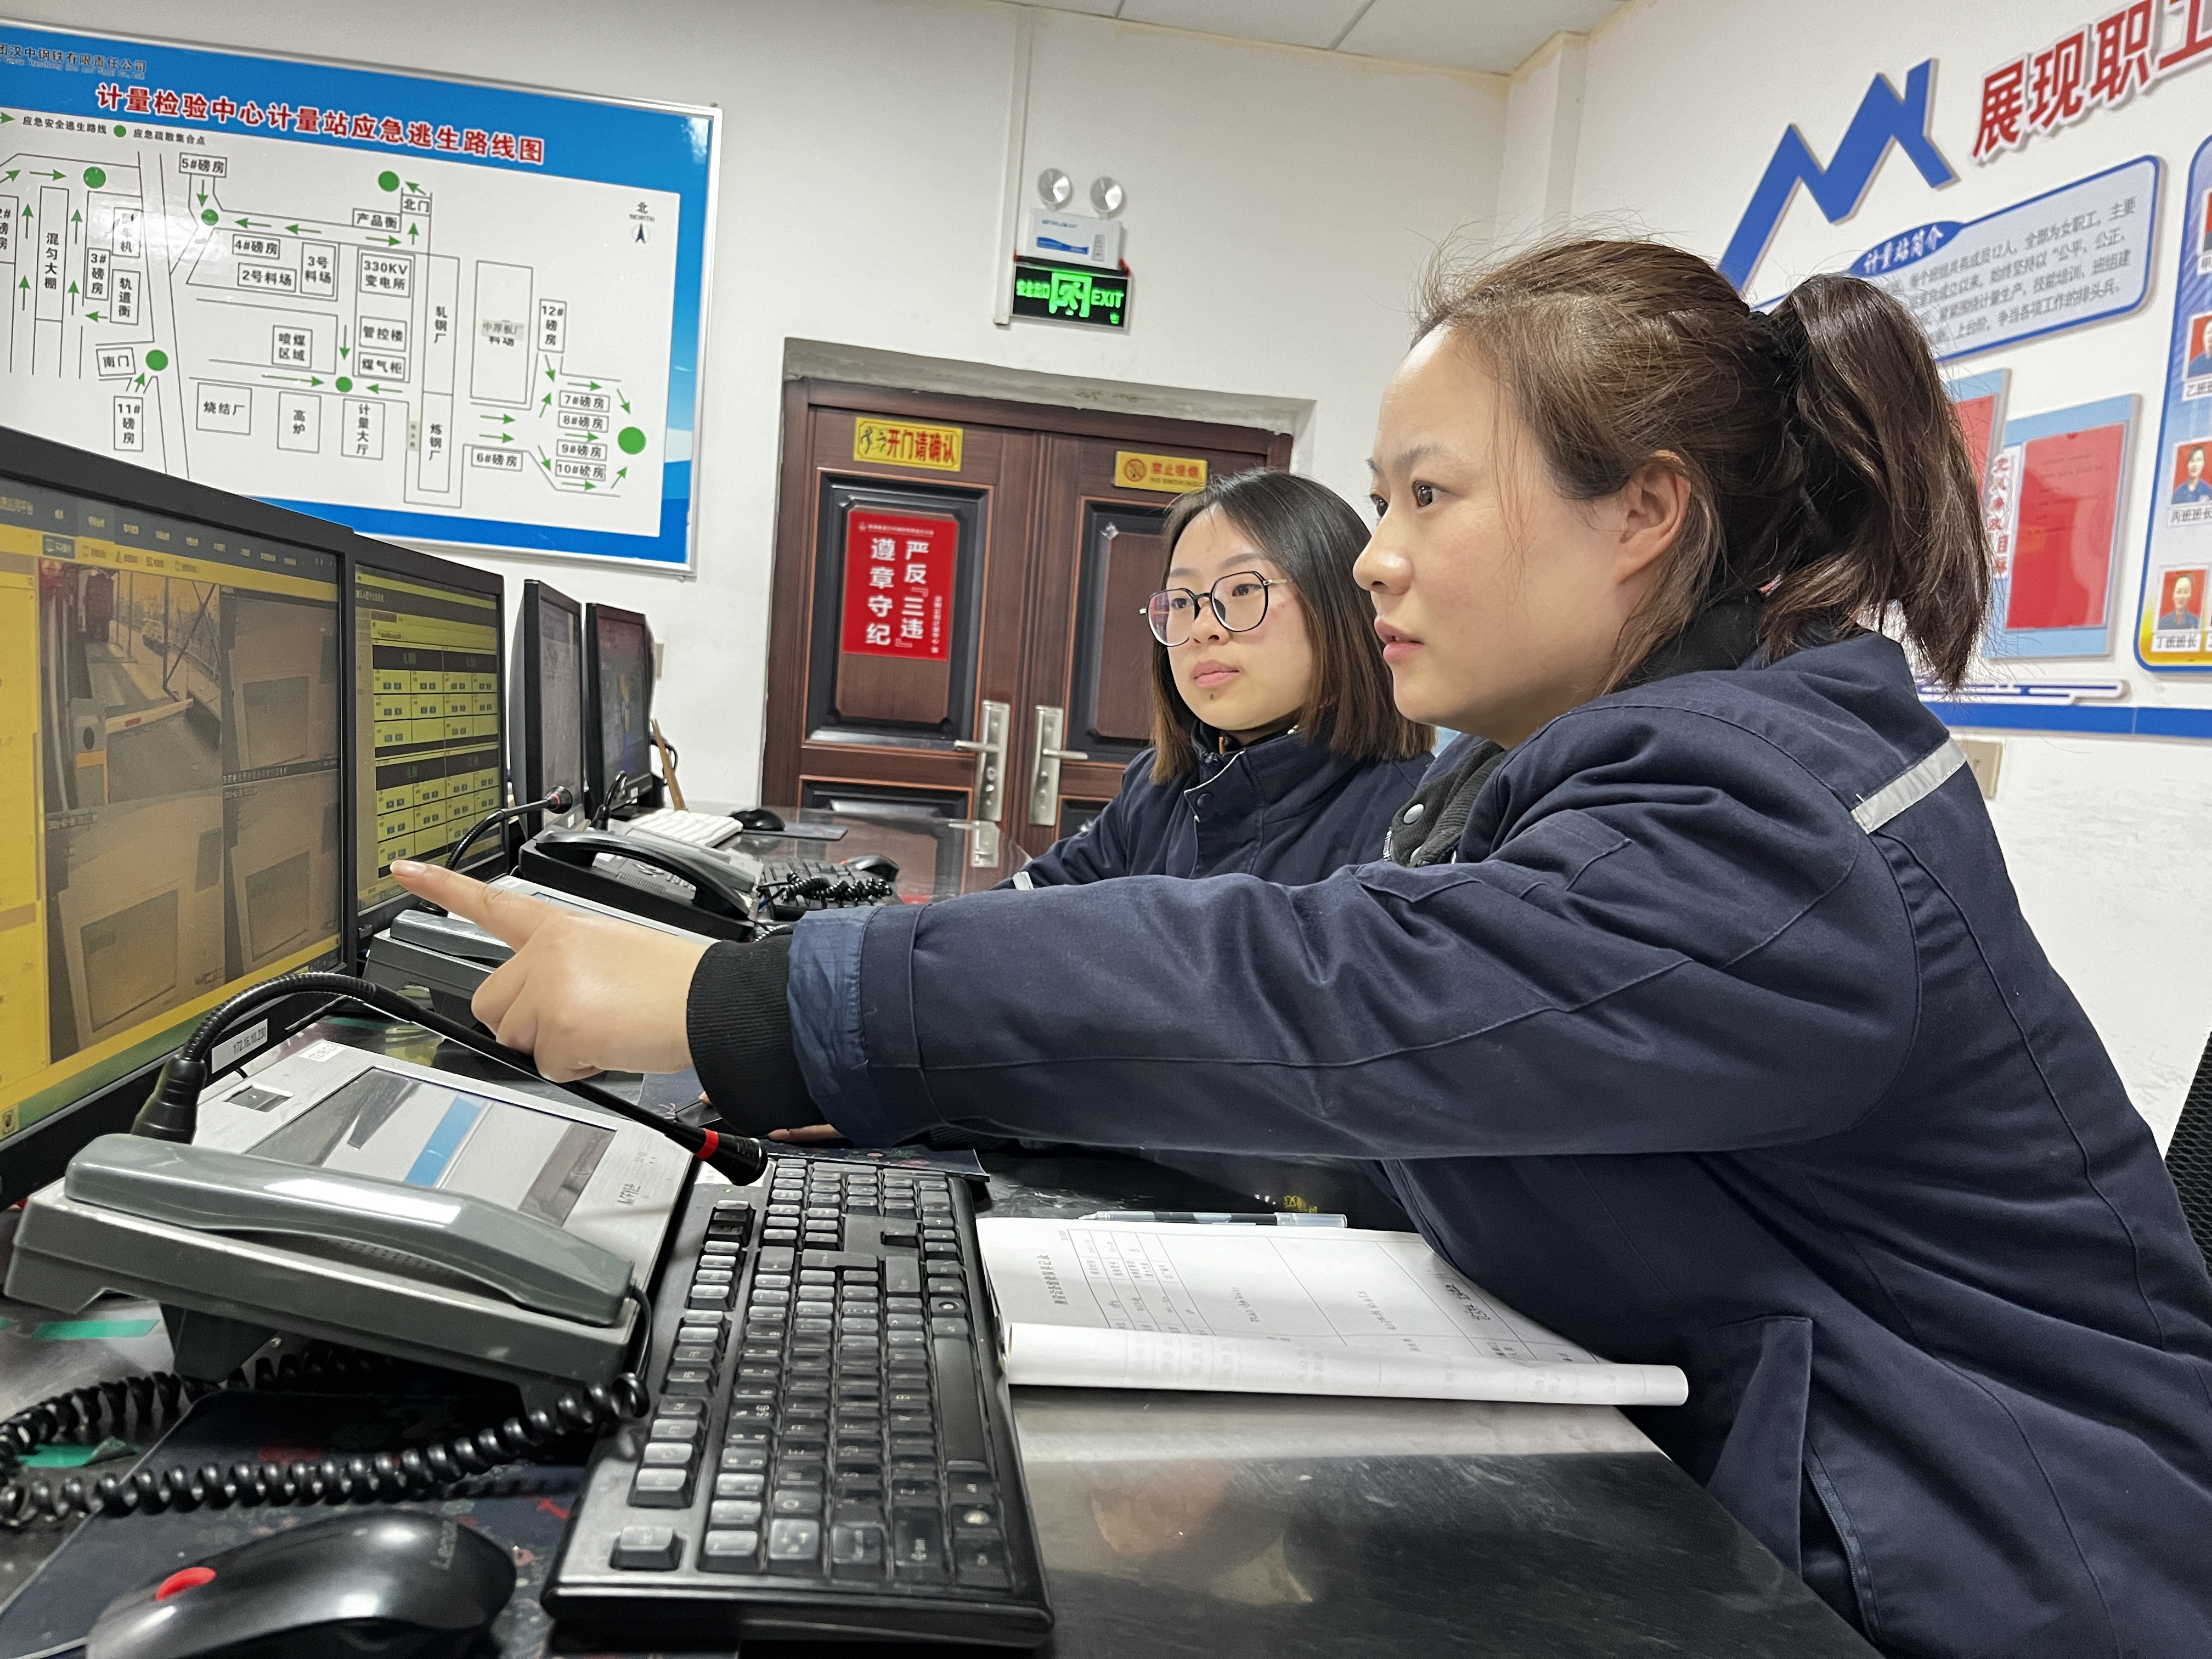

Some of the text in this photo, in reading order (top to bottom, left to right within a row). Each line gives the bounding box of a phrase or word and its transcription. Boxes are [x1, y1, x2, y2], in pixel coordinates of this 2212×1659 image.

[0, 44, 145, 72] 团汉中钢铁有限责任公司
[22, 116, 108, 134] 应急安全逃生路线
[97, 83, 544, 165] 计量检验中心计量站应急逃生路线图
[133, 128, 206, 145] 应急疏散集合点
[182, 158, 225, 173] 5#磅房
[404, 198, 429, 213] 北门
[636, 201, 648, 214] 北
[357, 212, 398, 229] 产品衡
[235, 240, 278, 255] 4#磅房
[44, 233, 59, 289] 混匀大棚
[308, 256, 328, 267] 3号
[364, 261, 408, 275] 330KV
[242, 269, 292, 286] 2号料场
[305, 269, 332, 284] 料场
[365, 276, 405, 290] 变电所
[119, 278, 132, 317] 轨道衡
[1091, 289, 1125, 308] EXIT
[434, 306, 448, 343] 轧钢厂
[364, 326, 403, 342] 管控楼
[103, 356, 129, 368] 南门
[279, 348, 304, 362] 区域
[362, 358, 403, 375] 煤气柜
[204, 401, 245, 415] 烧结厂
[565, 395, 605, 409] 7#磅房
[293, 410, 306, 435] 高炉
[357, 404, 370, 456] 计量大厅
[563, 416, 603, 430] 8#磅房
[429, 423, 442, 460] 炼钢厂
[885, 429, 956, 464] 开门请确认
[562, 443, 602, 458] 9#磅房
[476, 454, 518, 468] 6#磅房
[557, 464, 604, 477] 10#磅房
[866, 537, 895, 645] 遵章守纪
[234, 1026, 267, 1055] 172.16.10.230
